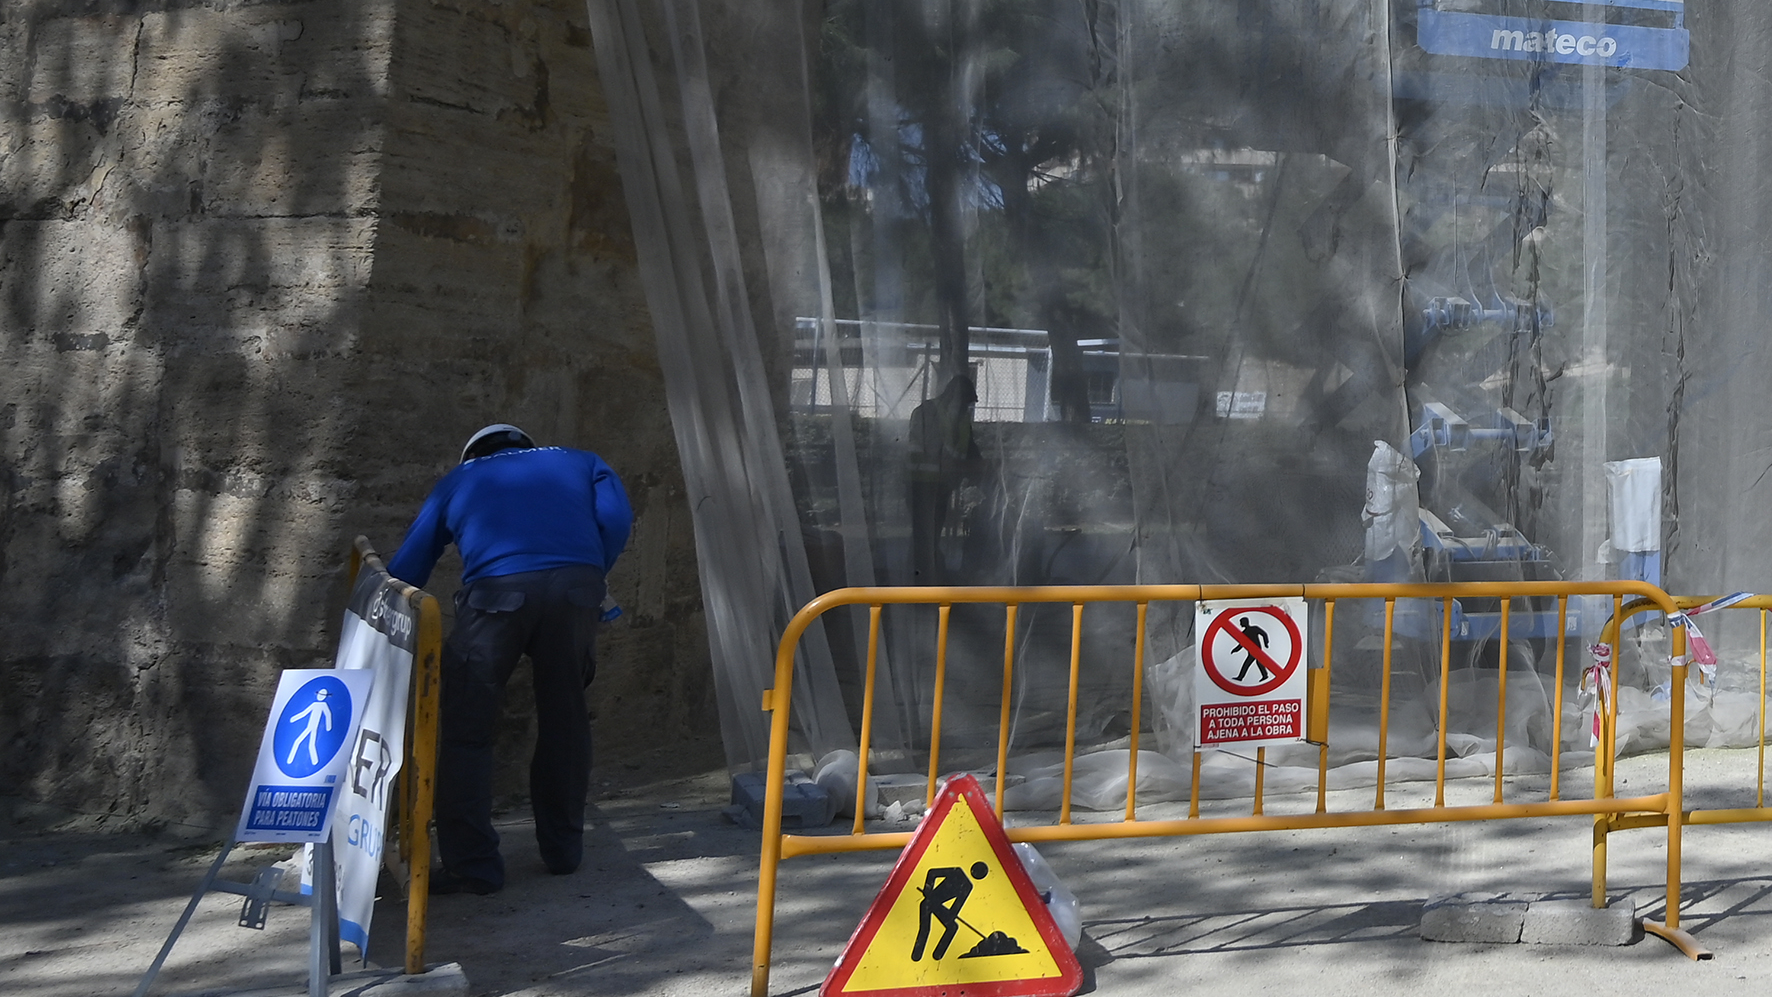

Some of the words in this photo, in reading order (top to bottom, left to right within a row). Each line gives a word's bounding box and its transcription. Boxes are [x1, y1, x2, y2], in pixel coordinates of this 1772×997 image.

[1490, 27, 1617, 57] mateco
[1203, 705, 1256, 718] PROHIBIDO
[1258, 704, 1270, 714] EL
[1272, 702, 1299, 713] PASO
[1209, 719, 1216, 729] A
[1218, 717, 1245, 728] TODA
[1247, 714, 1293, 726] PERSONA
[1207, 728, 1239, 740] AJENA
[1241, 727, 1248, 737] A
[1250, 726, 1263, 736] LA
[1265, 724, 1293, 735] OBRA
[257, 788, 273, 807] VÍA
[272, 791, 327, 809] OBLIGATORIA
[253, 809, 276, 826] PARA
[276, 810, 320, 827] PEATONES
[348, 813, 384, 862] GRUP
